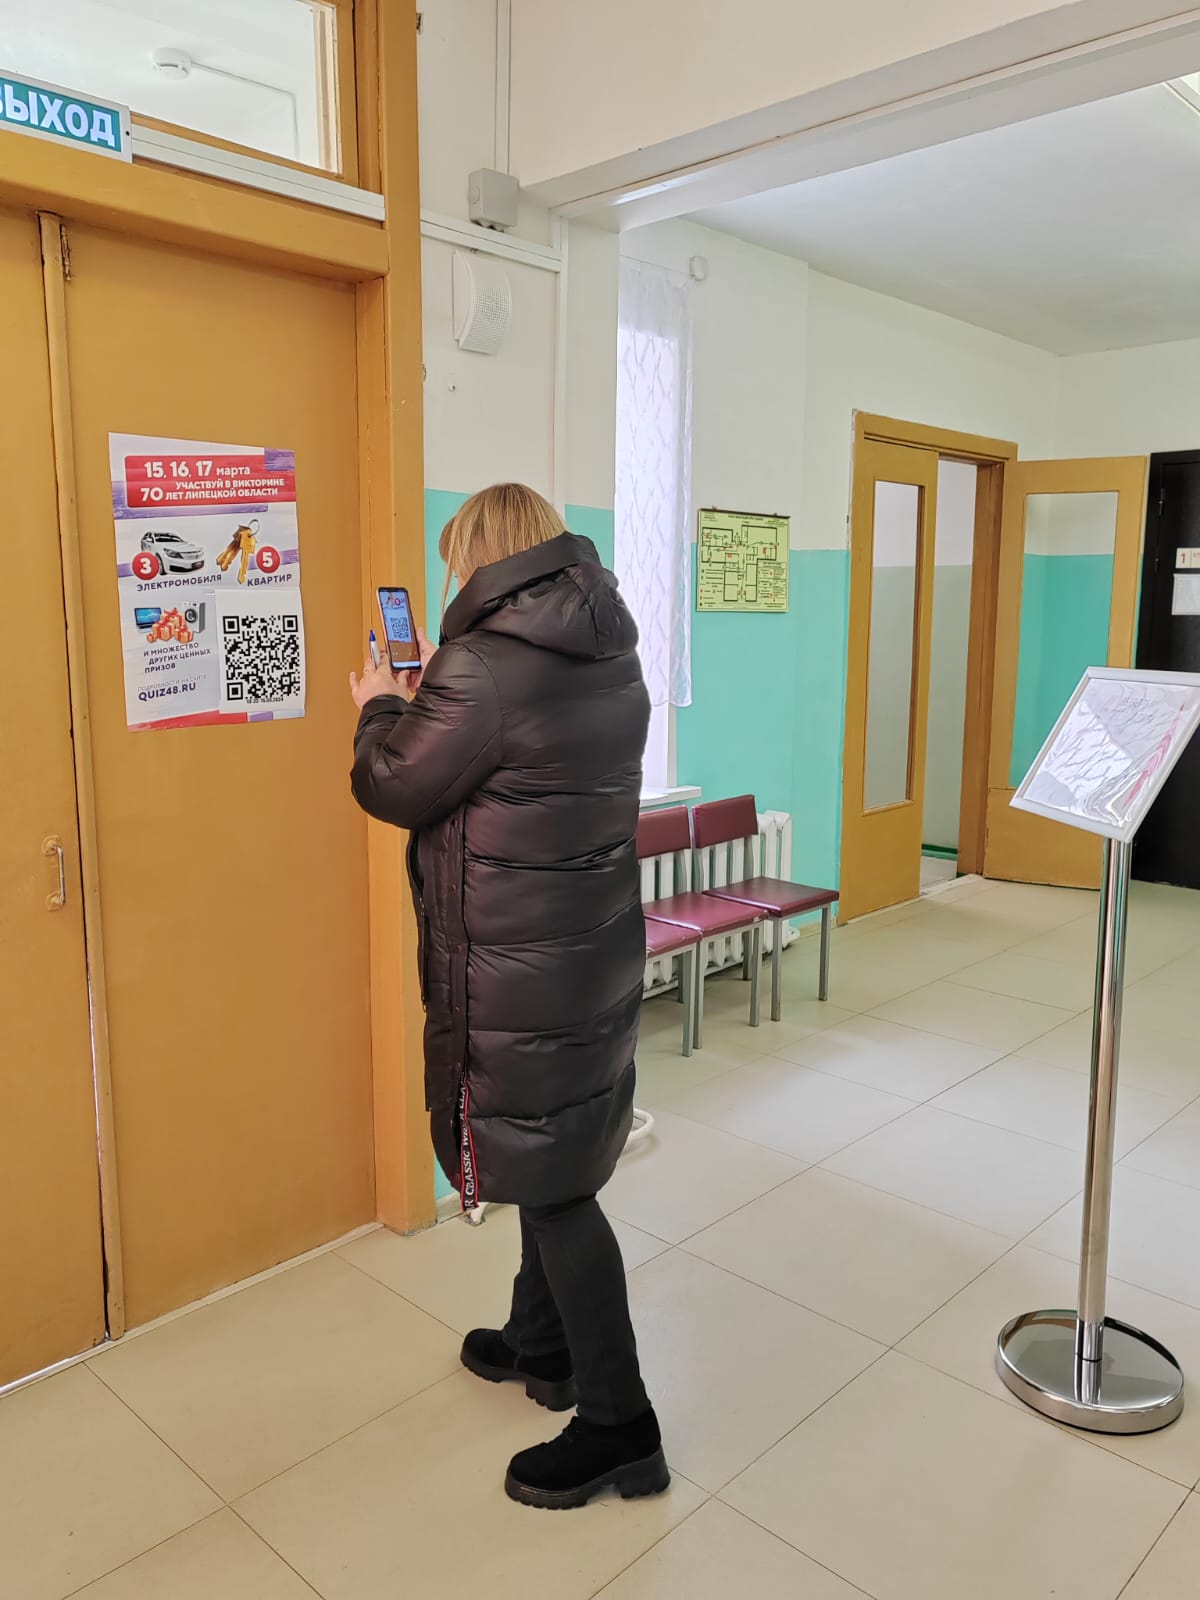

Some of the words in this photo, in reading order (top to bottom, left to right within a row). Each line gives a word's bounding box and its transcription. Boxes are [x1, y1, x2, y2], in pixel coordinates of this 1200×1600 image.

[0, 82, 116, 147] ЫХОД
[196, 460, 213, 477] 17
[216, 465, 251, 478] марта
[176, 478, 223, 490] УЧАСТВУЙ
[225, 480, 232, 489] В
[233, 478, 285, 488] ВИКТОРИНЕ
[140, 487, 163, 501] 70
[165, 490, 184, 500] ЛЕТ
[184, 488, 237, 501] ЛИПЕЦКОЙ
[238, 487, 278, 498] ОБЛАСТИ
[140, 557, 152, 575] 3
[261, 551, 274, 567] 5
[136, 574, 222, 592] ЭЛЕКТРОМОБИЛЯ
[247, 573, 293, 587] КВАРТИР
[148, 654, 178, 666] ДРУГИХ
[179, 648, 211, 660] ЦЕННЫХ
[151, 642, 199, 656] МНОЖЕСТВО
[144, 662, 176, 674] ПРИЗОВ
[138, 682, 197, 701] QUIZ48.RU
